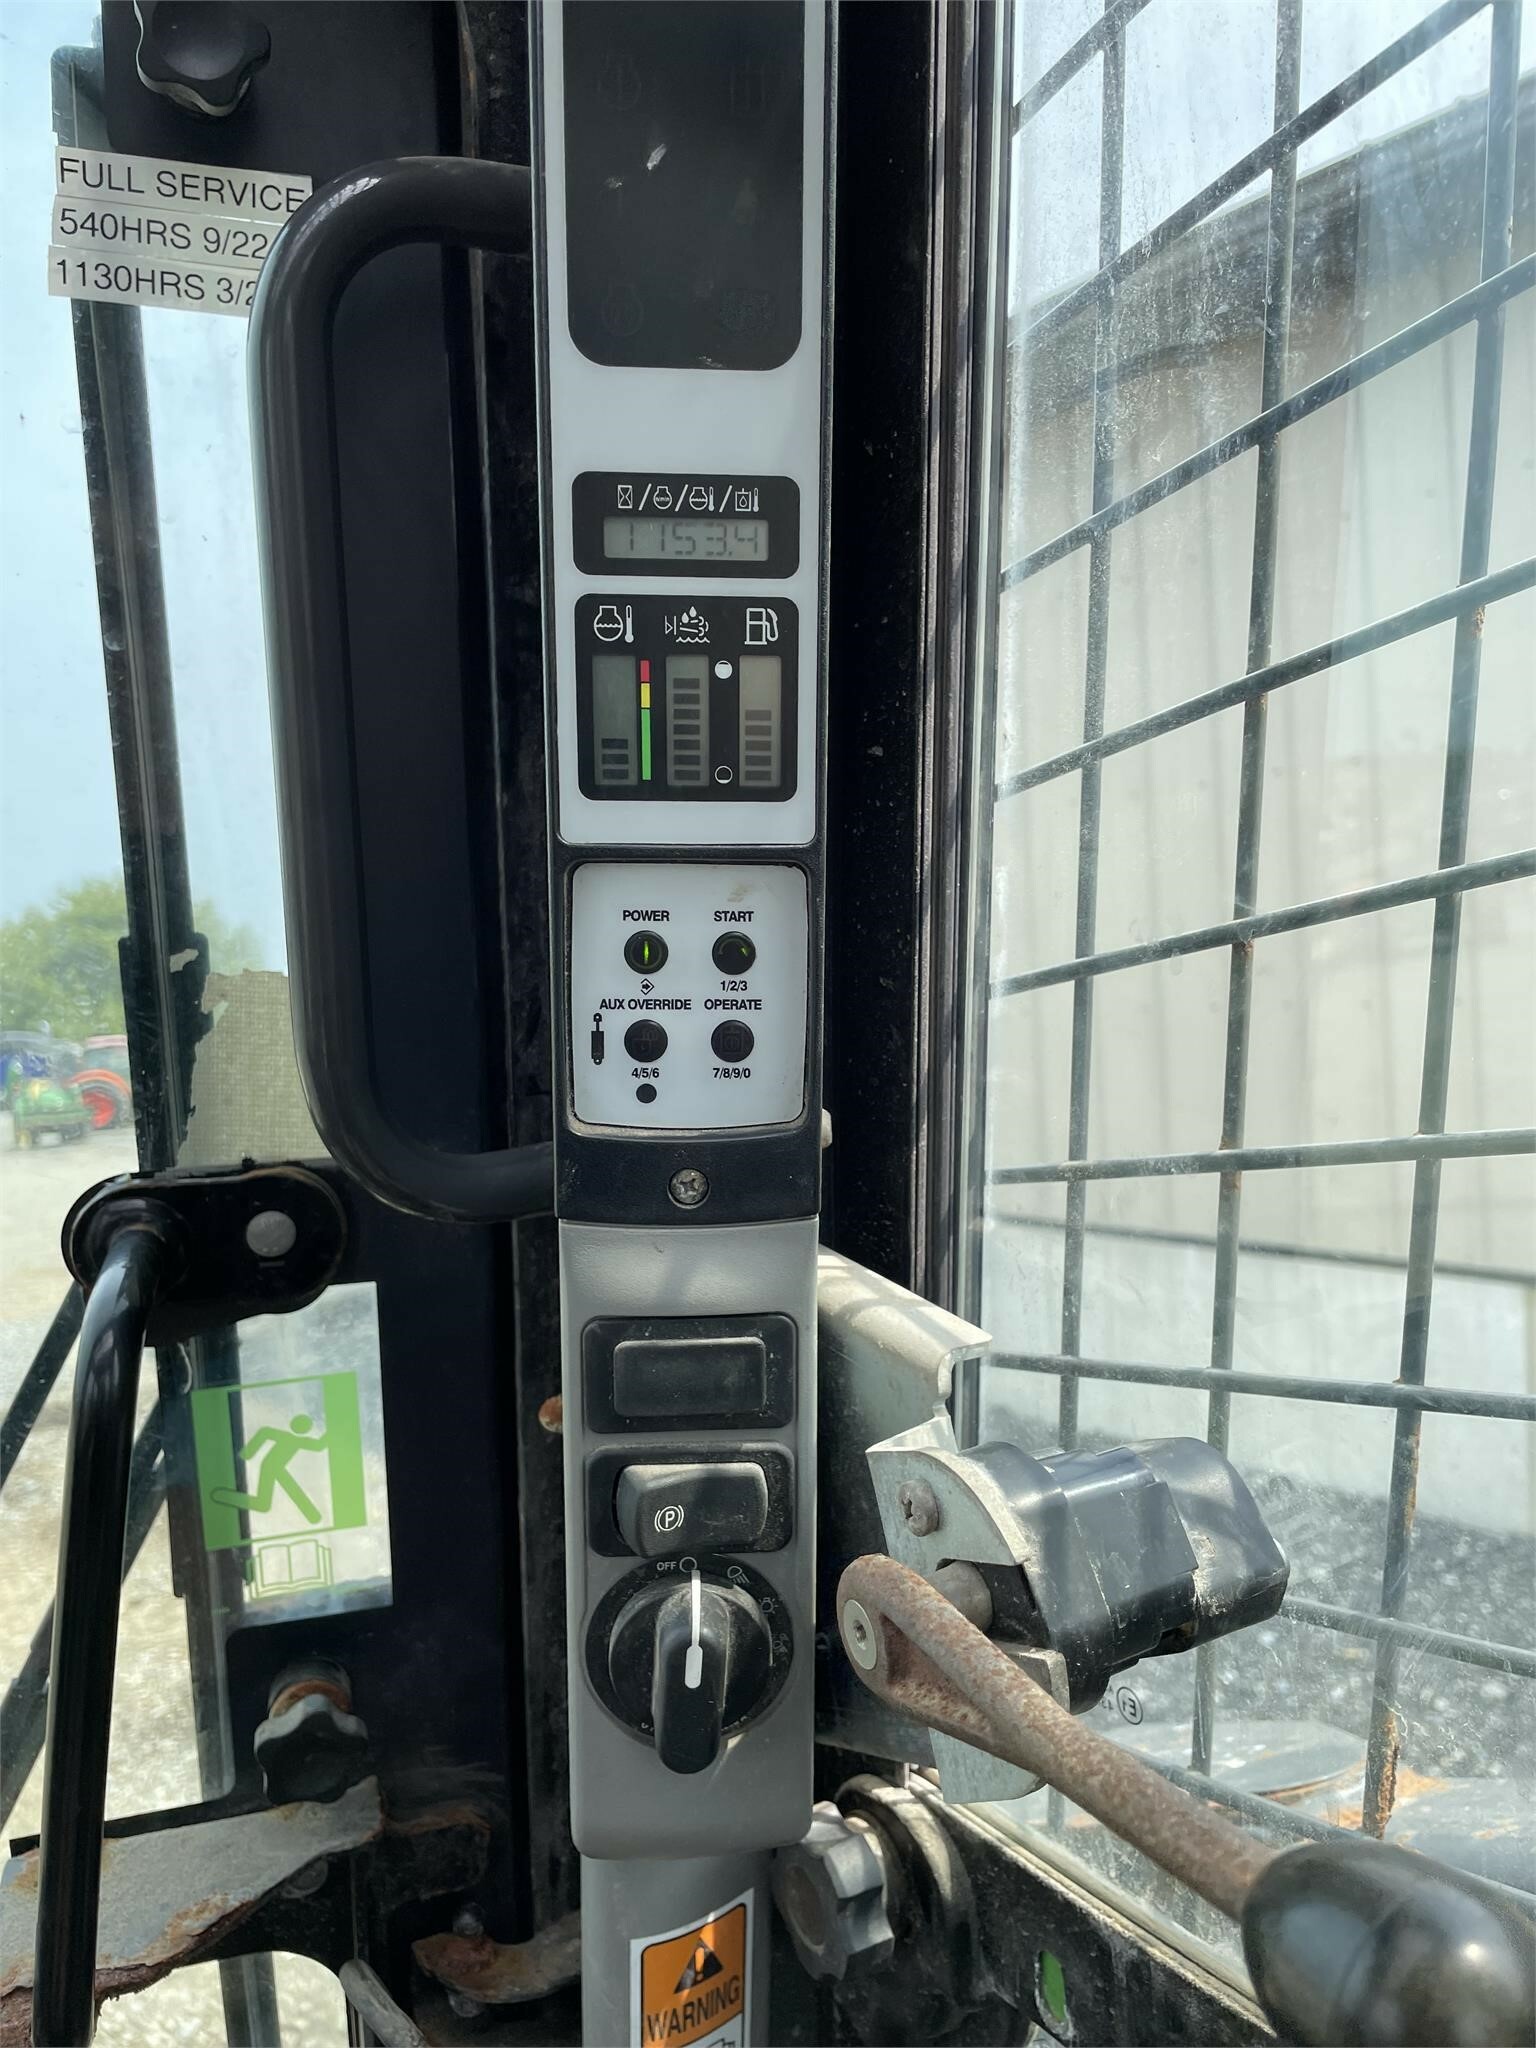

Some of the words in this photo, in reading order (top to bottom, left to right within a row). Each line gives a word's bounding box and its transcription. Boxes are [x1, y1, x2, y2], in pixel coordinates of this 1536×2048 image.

[59, 157, 145, 194] FULL
[156, 170, 306, 213] SERVICE
[60, 207, 191, 250] 540HRS
[203, 227, 268, 260] 9/22
[56, 259, 205, 301] 1130HRS
[622, 910, 670, 922] POWER
[713, 910, 754, 922] START
[720, 980, 748, 991] 1/2/3
[599, 998, 626, 1010] AUX
[627, 998, 692, 1011] OVERRIDE
[704, 998, 763, 1011] OPERATE
[631, 1067, 660, 1079] 4/5/6
[712, 1067, 751, 1079] 7/8/9/0
[656, 1561, 677, 1571] OFF
[647, 1975, 740, 2041] WARNING
